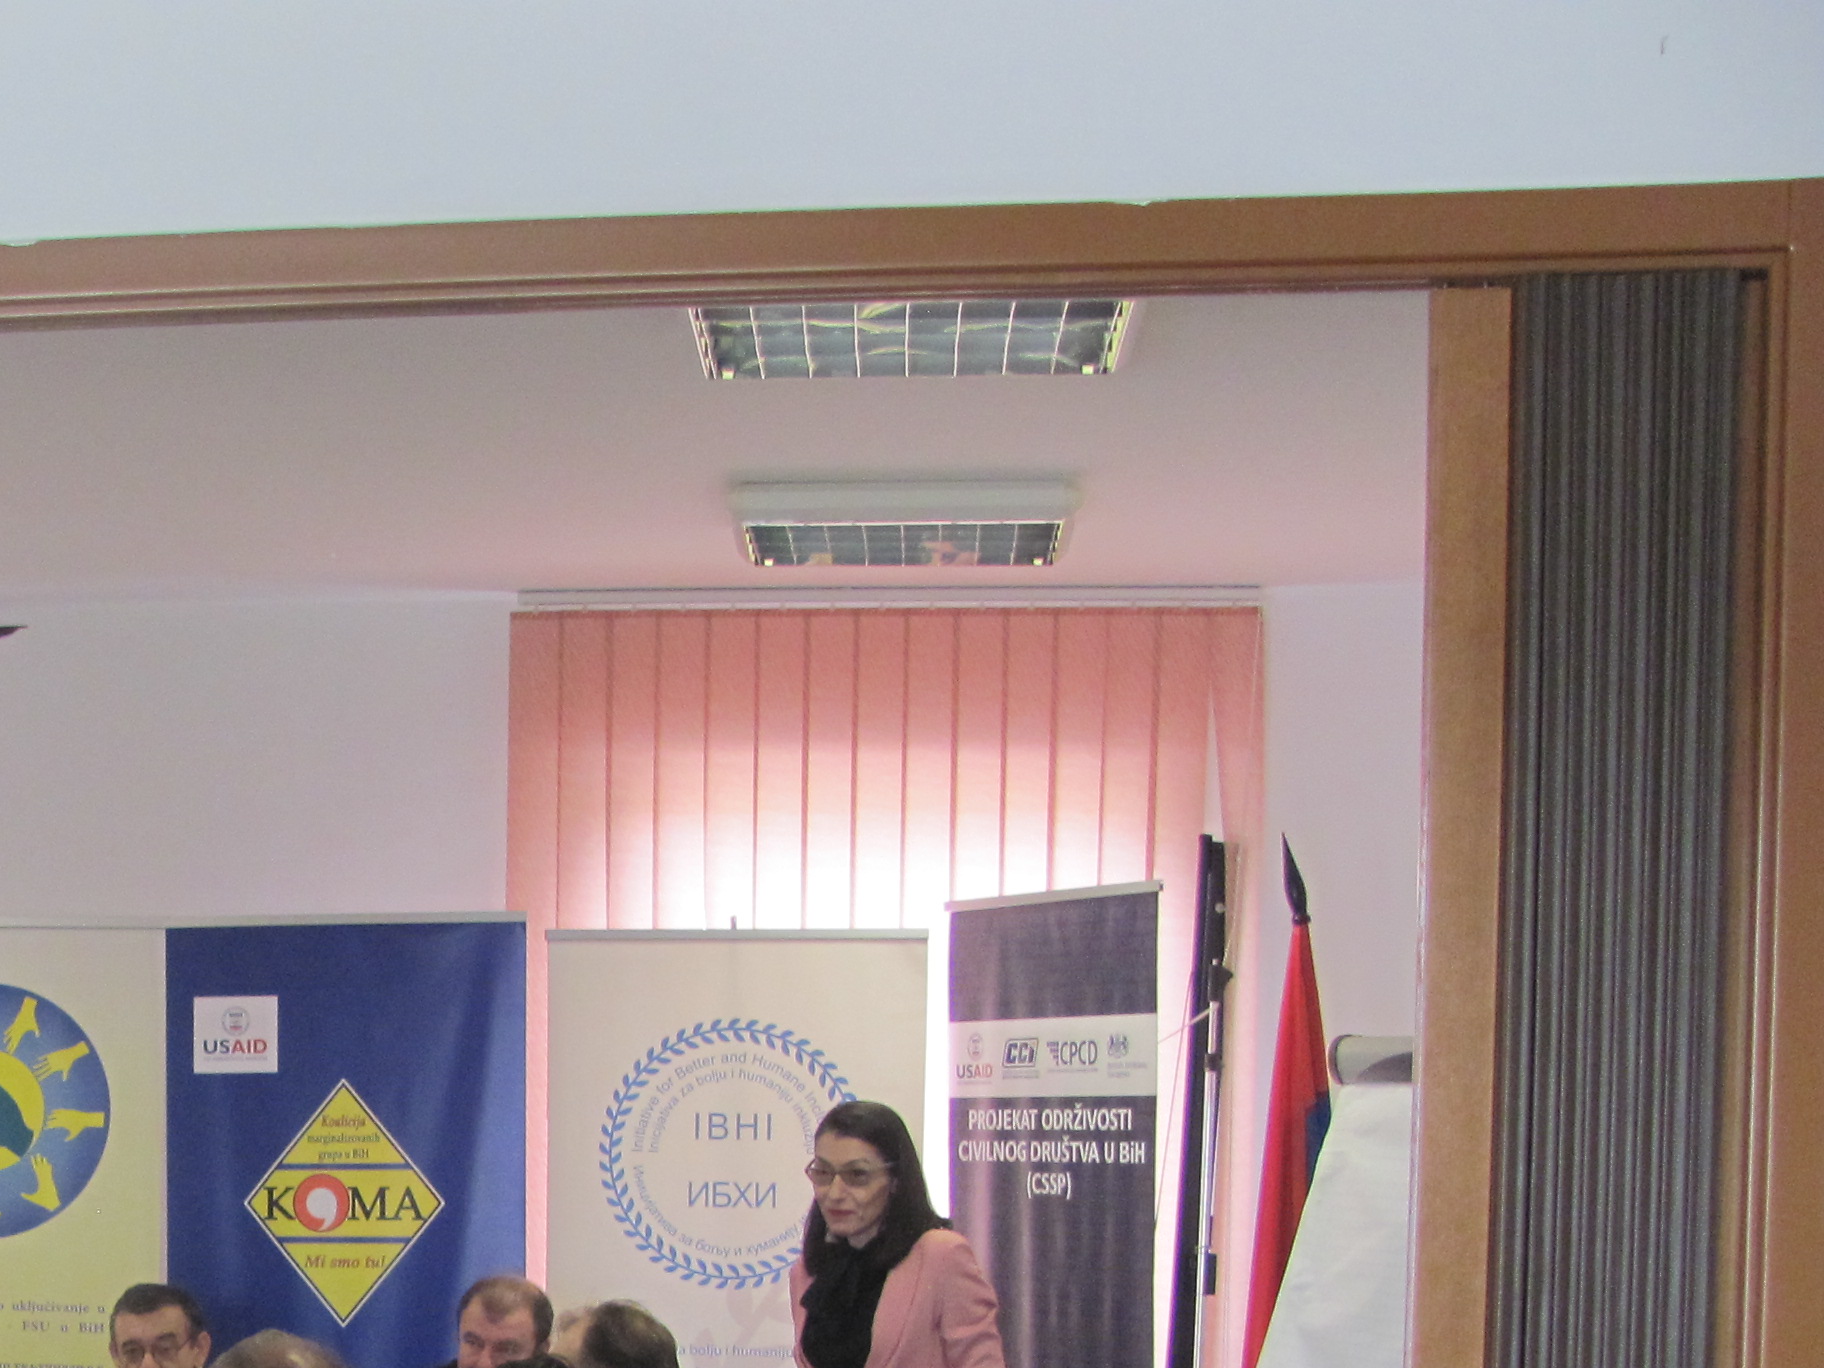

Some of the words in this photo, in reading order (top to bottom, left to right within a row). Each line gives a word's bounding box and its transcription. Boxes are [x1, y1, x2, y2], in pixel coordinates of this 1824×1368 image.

[203, 1039, 268, 1055] USAID
[1060, 1040, 1098, 1066] CPCD
[956, 1063, 993, 1079] USAID
[680, 1082, 695, 1098] za
[695, 1069, 727, 1087] bolju
[738, 1068, 794, 1103] humaniju
[631, 1096, 660, 1153] Initiative
[656, 1077, 674, 1095] for
[674, 1056, 715, 1080] Better
[721, 1052, 747, 1064] and
[752, 1053, 806, 1093] Humane
[321, 1114, 366, 1131] Koalicija
[968, 1108, 1038, 1131] PROJEKAT
[1041, 1103, 1133, 1131] ODRŽIVOSTI
[694, 1112, 773, 1141] IBHI
[318, 1151, 343, 1163] grupa
[352, 1148, 369, 1159] BiH
[958, 1140, 1027, 1163] CIVILNOG
[1030, 1135, 1100, 1164] DRUŠTVA
[1103, 1141, 1114, 1164] U
[1119, 1141, 1146, 1164] BiH
[1026, 1170, 1072, 1200] (CSSP)
[687, 1181, 778, 1209] ИБХИ
[678, 1233, 693, 1246] за
[305, 1255, 326, 1269] Mi
[330, 1257, 360, 1269] smo
[365, 1255, 386, 1269] tu!
[12, 1300, 90, 1314] uključivanje
[22, 1320, 51, 1332] FSU
[79, 1322, 106, 1334] BiH
[689, 1344, 722, 1357] bolju
